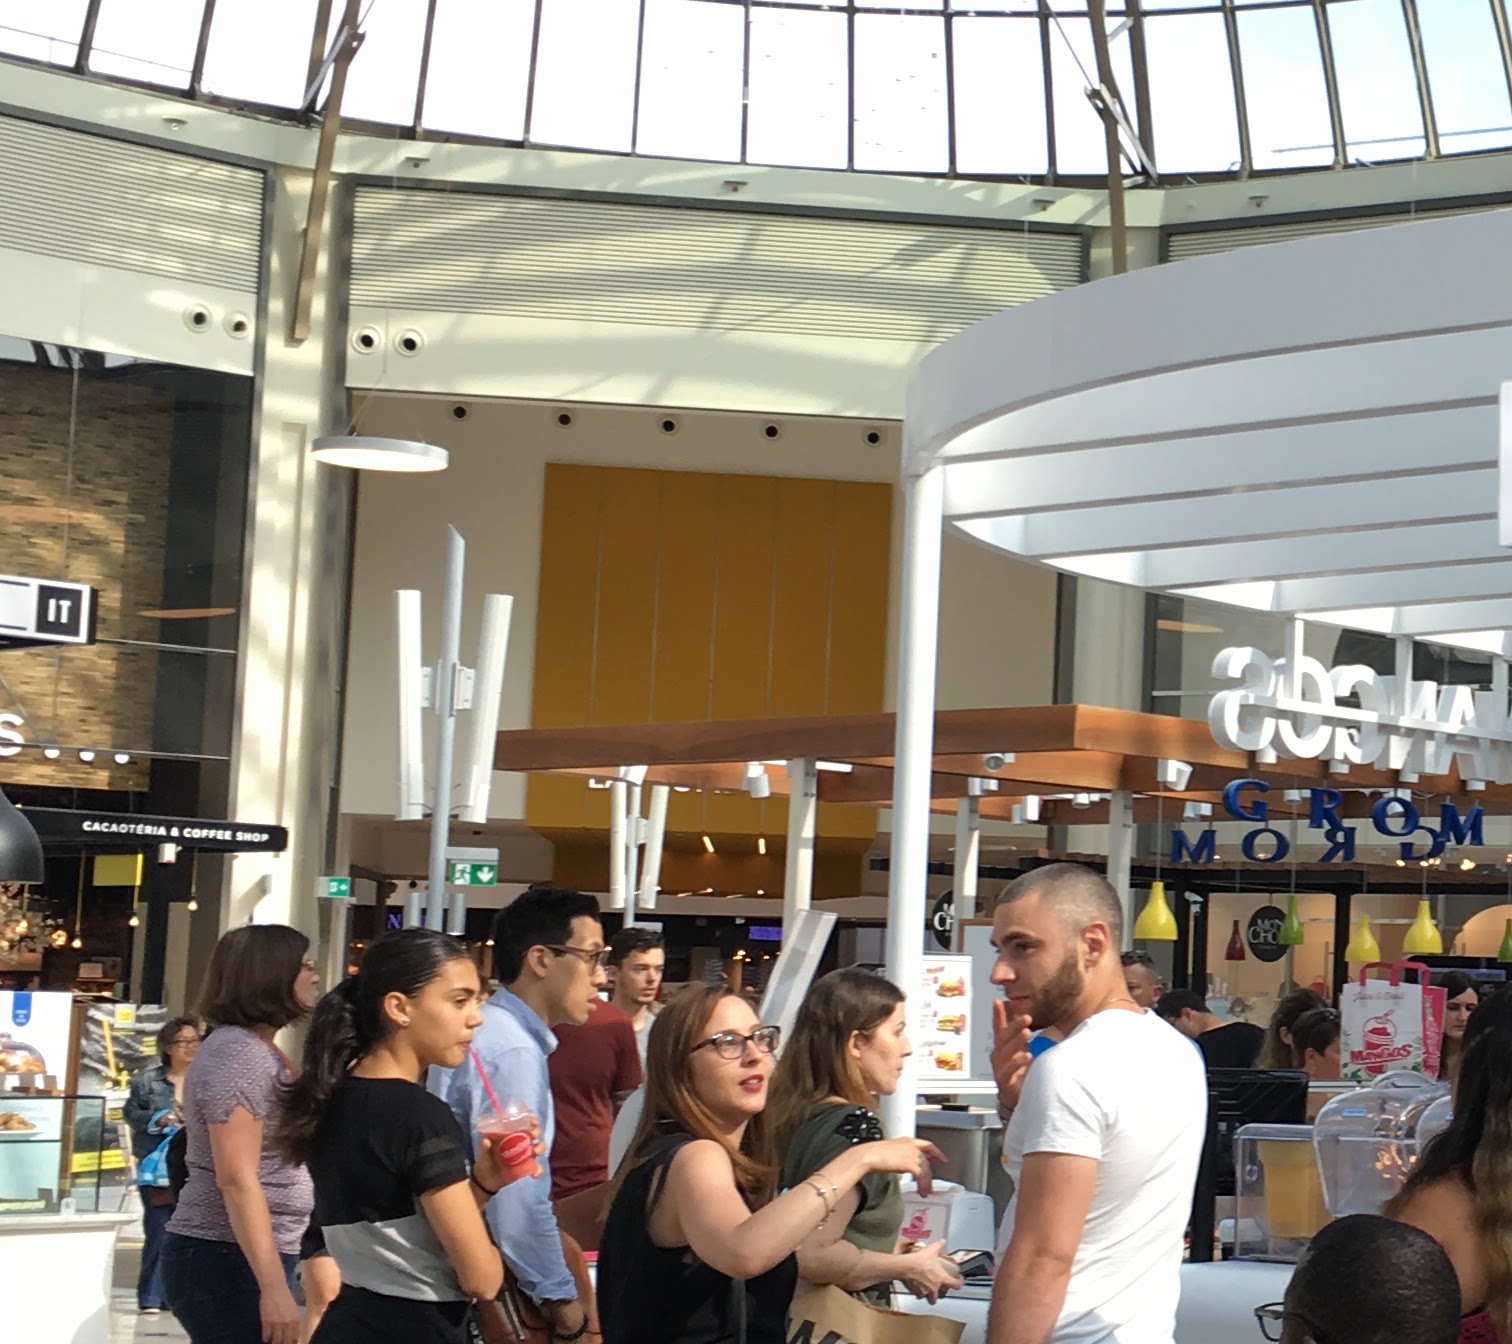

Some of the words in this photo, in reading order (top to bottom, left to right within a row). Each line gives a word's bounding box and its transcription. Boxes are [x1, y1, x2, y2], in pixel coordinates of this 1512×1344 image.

[47, 598, 72, 624] IT
[1222, 778, 1484, 846] GROM
[82, 820, 167, 836] CACAOTÉRIA
[169, 826, 180, 837] &
[183, 827, 232, 840] COFFEE
[235, 831, 270, 842] SHOP
